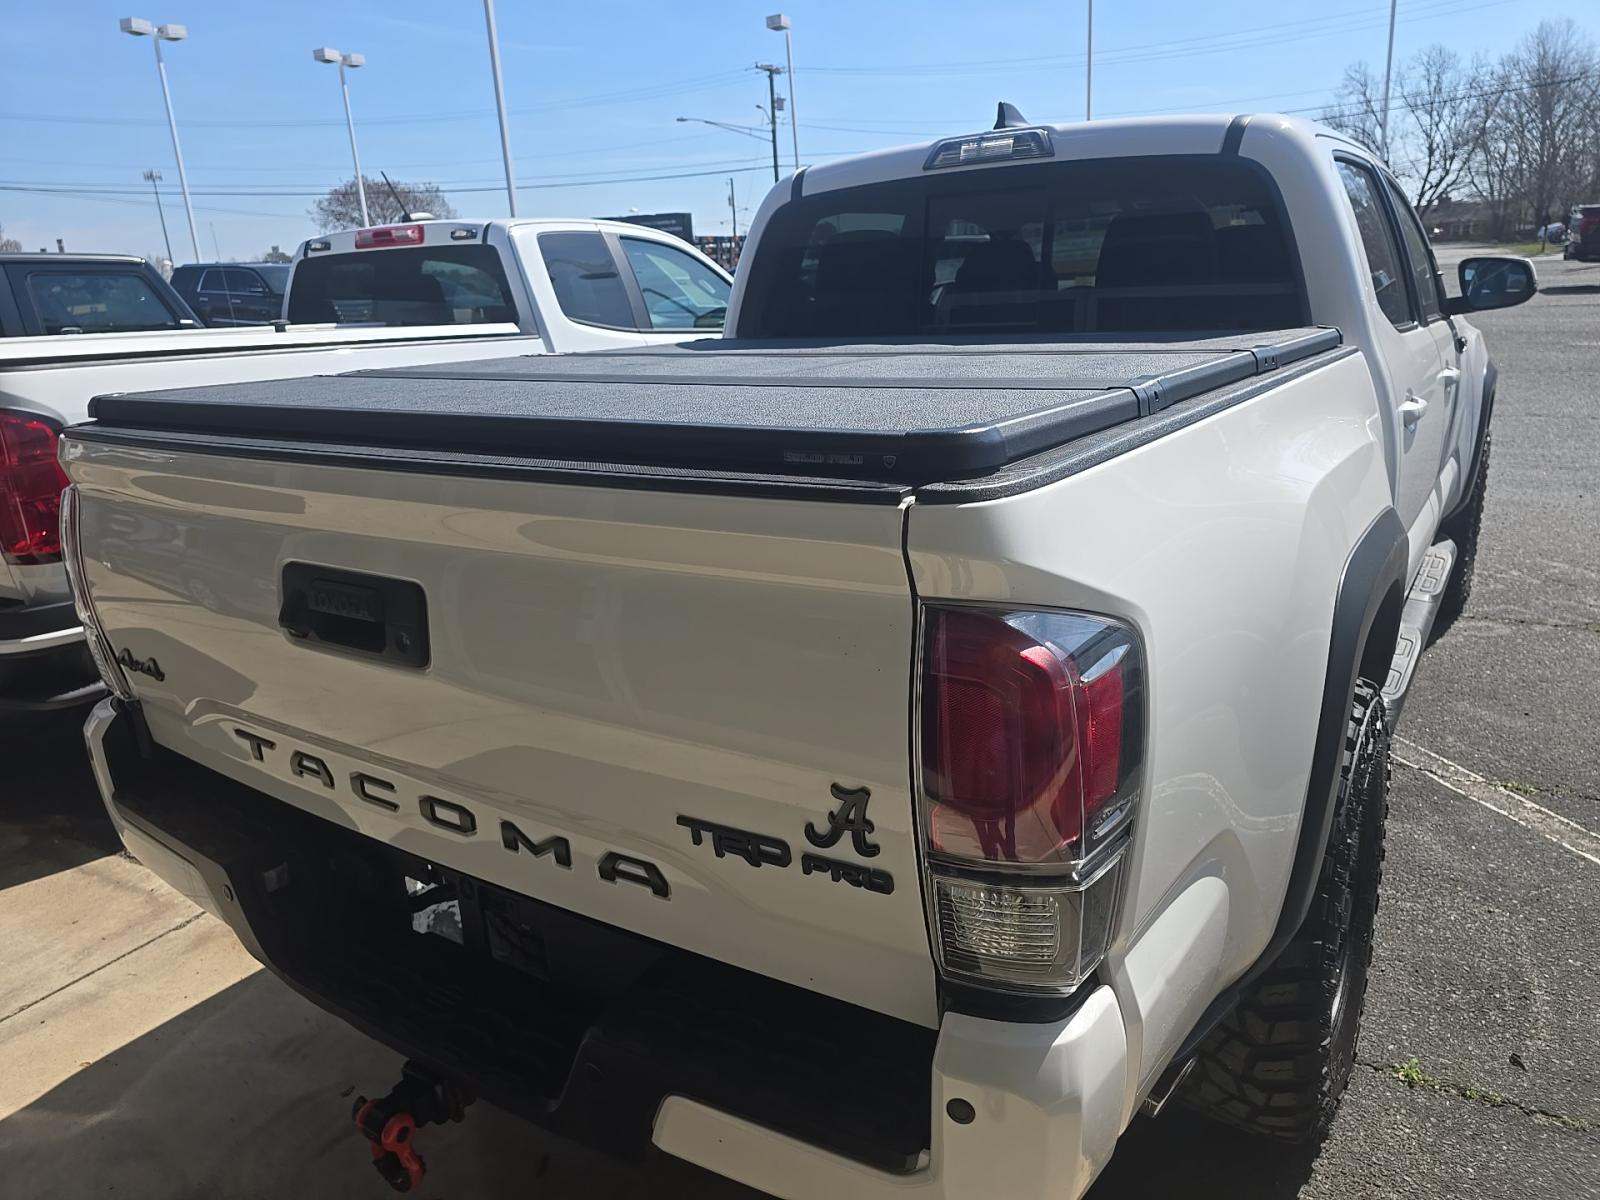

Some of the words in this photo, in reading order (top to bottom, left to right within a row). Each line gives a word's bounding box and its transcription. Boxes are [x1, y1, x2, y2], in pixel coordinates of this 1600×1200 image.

[234, 728, 671, 899] TACOMA
[804, 782, 881, 857] A
[677, 814, 792, 868] TRD
[801, 852, 895, 895] PRO
